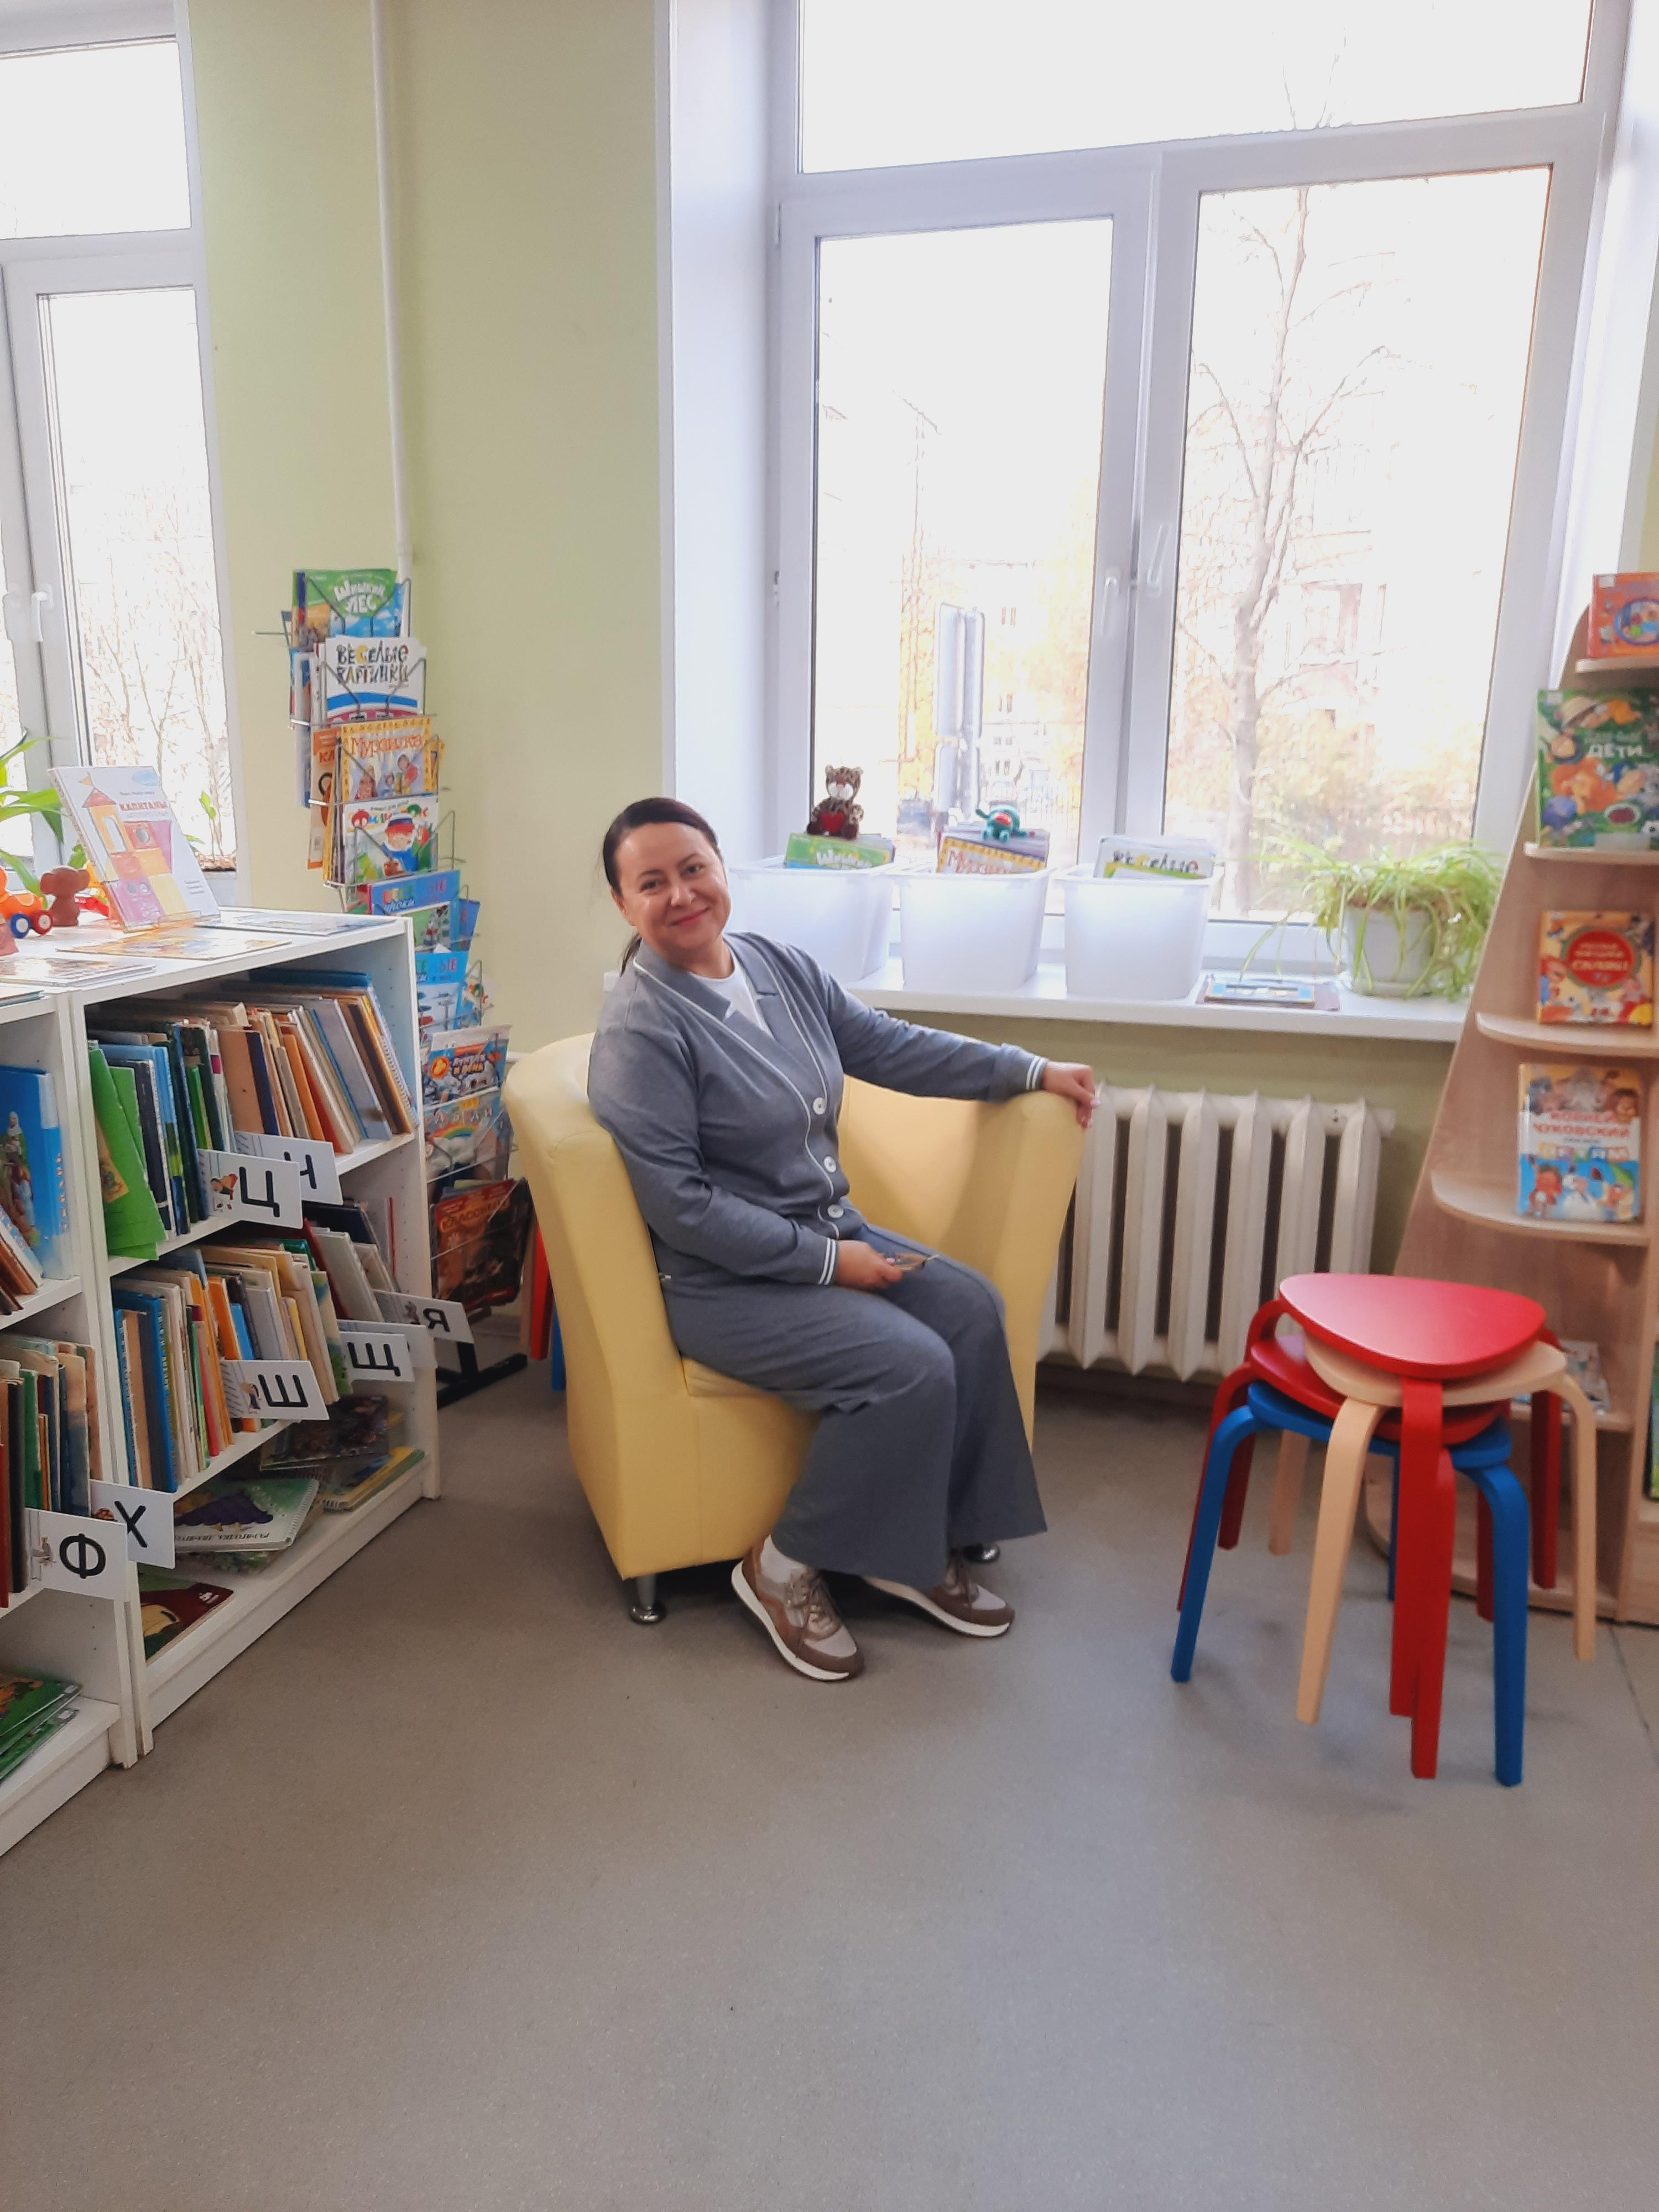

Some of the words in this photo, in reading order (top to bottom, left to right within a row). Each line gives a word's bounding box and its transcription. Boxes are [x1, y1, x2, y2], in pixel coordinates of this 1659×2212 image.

[239, 1166, 280, 1217] Ц
[423, 1308, 450, 1332] Я
[347, 1342, 401, 1376] Щ
[258, 1374, 309, 1407] Ш
[114, 1500, 148, 1548] Х
[59, 1533, 106, 1579] Ф
